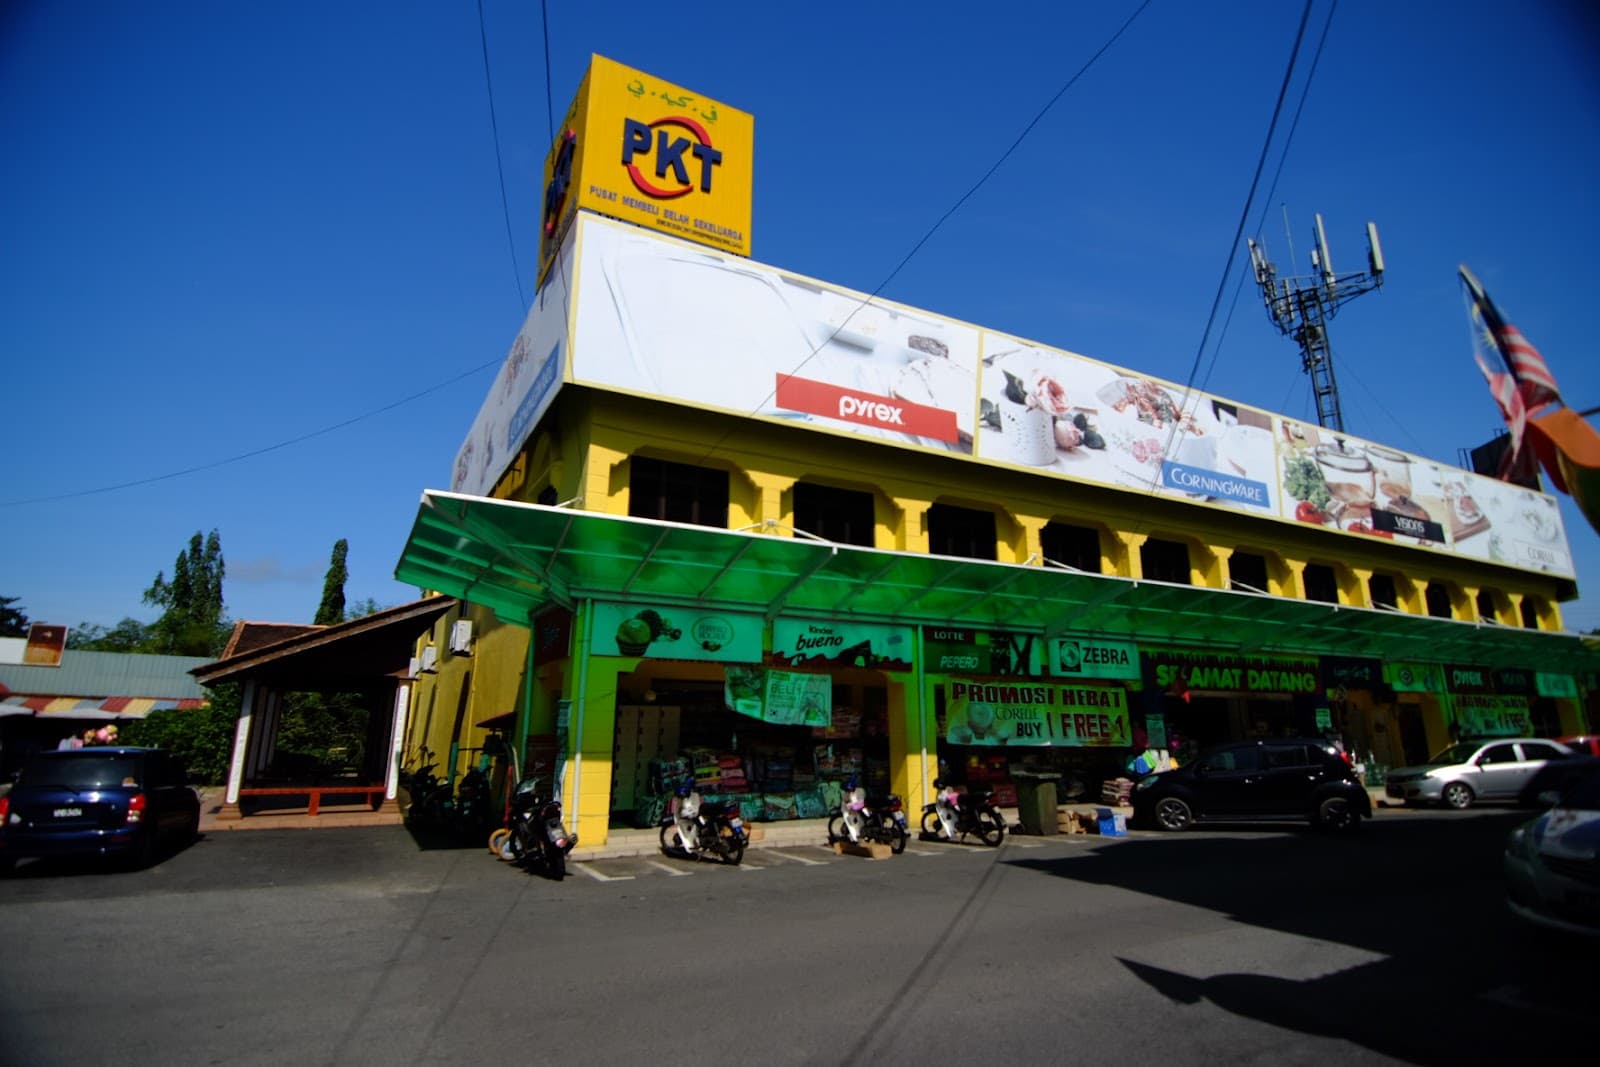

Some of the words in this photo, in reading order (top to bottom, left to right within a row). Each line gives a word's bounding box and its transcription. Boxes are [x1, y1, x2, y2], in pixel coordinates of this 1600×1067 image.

[622, 117, 722, 193] PKT
[590, 185, 617, 202] PUSAT
[622, 195, 659, 215] MEMBELI
[839, 395, 903, 425] pyrex
[1171, 467, 1262, 501] CORNINGWARE
[795, 633, 844, 652] bueno
[934, 631, 965, 641] LOTTE
[940, 655, 979, 669] PEPERO
[1082, 647, 1130, 665] ZEBRA
[1156, 664, 1242, 689] SEAMAT
[1247, 669, 1316, 692] DATANG
[952, 681, 1054, 705] PROMOSI
[1062, 688, 1121, 707] HEBAT
[1016, 722, 1042, 738] BUY
[1060, 713, 1110, 738] FREE
[1116, 714, 1125, 738] 1
